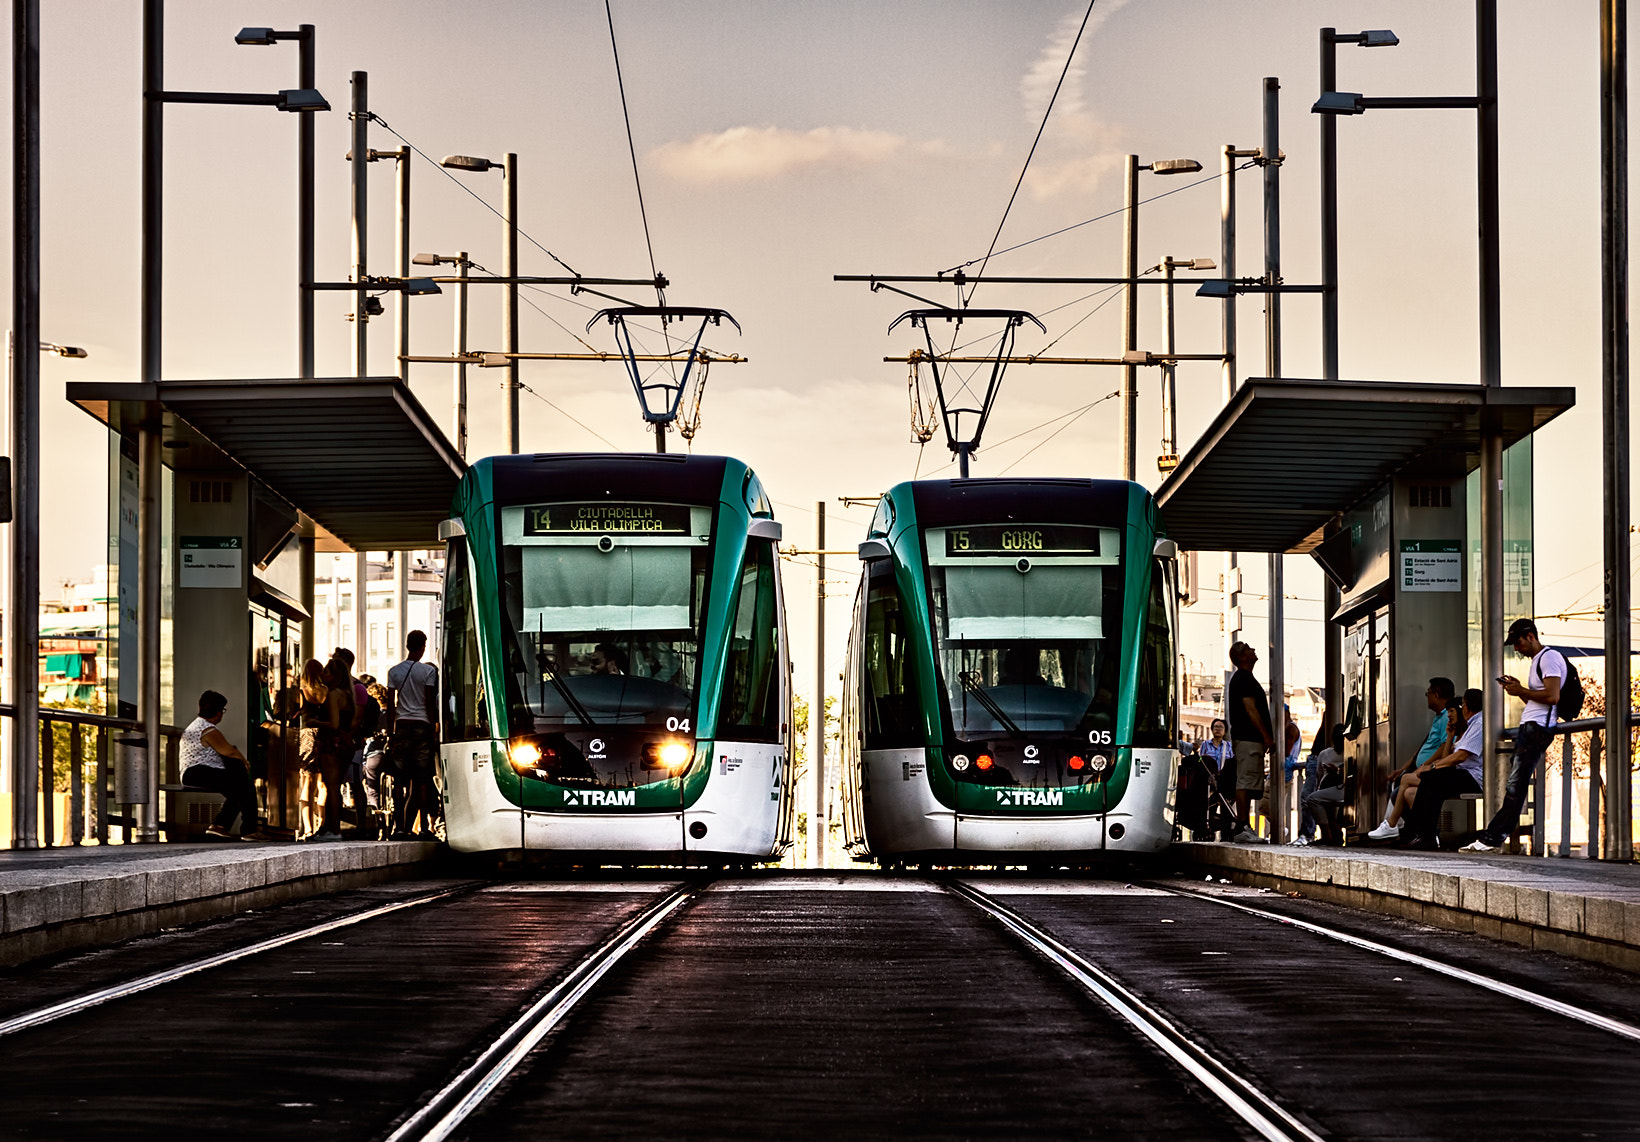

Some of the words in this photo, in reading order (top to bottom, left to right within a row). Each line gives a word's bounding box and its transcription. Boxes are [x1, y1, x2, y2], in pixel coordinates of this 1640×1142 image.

[531, 509, 551, 530] T4
[578, 507, 653, 519] CIUTADELLA
[570, 519, 600, 531] VILA
[604, 519, 663, 531] OLIMPICA
[230, 538, 238, 548] 2
[951, 531, 970, 549] T5
[1002, 531, 1043, 549] GORG
[1415, 542, 1420, 551] 1
[666, 716, 691, 733] 04
[1089, 730, 1111, 745] 05
[579, 790, 636, 805] TRAM
[1012, 791, 1063, 806] TRAM
